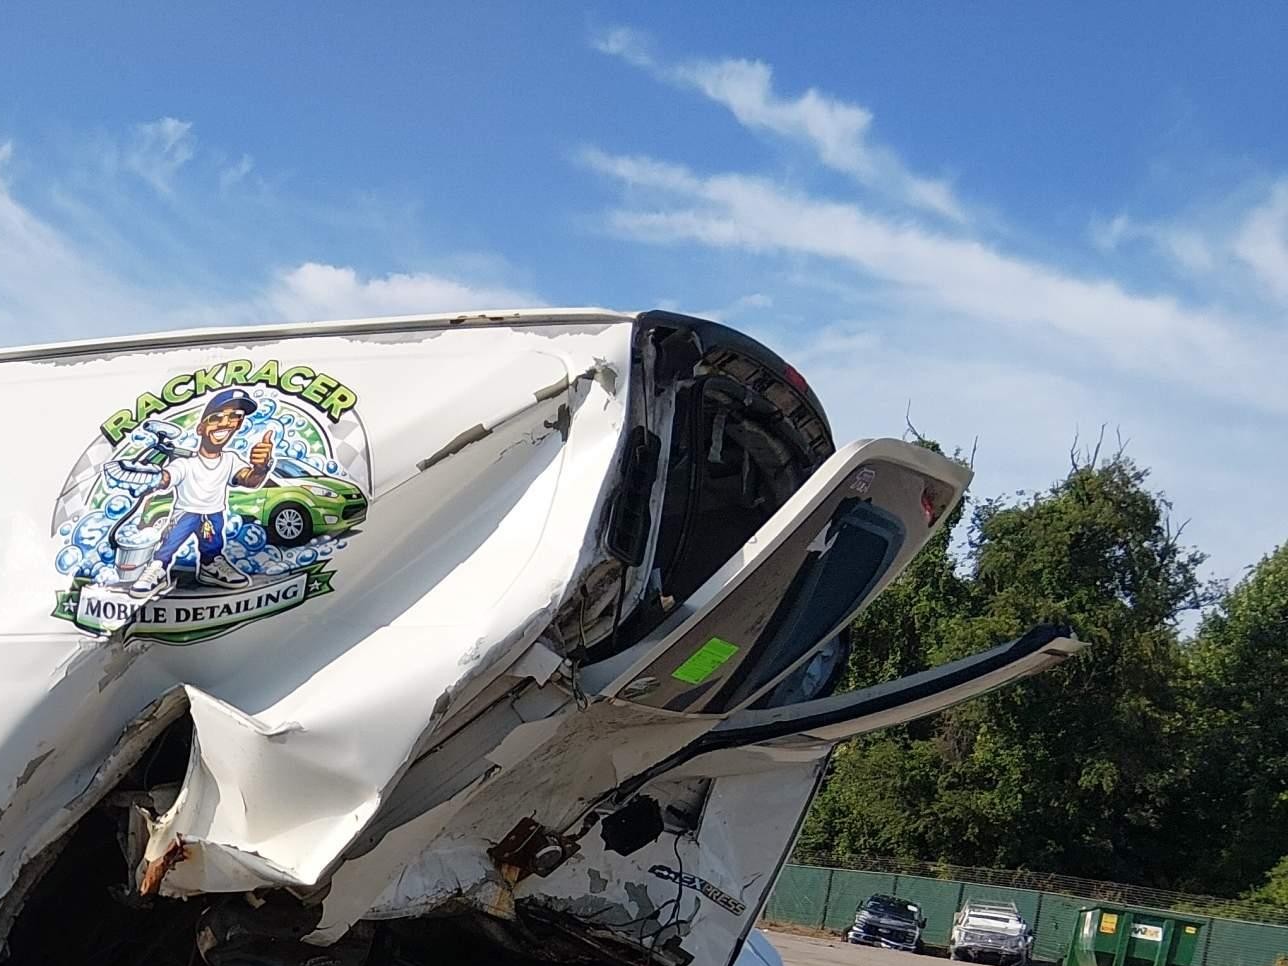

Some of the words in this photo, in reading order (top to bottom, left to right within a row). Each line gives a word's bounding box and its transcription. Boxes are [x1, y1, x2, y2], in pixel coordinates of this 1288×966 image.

[101, 359, 358, 446] RACKRACER
[85, 597, 167, 624] MOBILE
[175, 583, 299, 623] DETAILING
